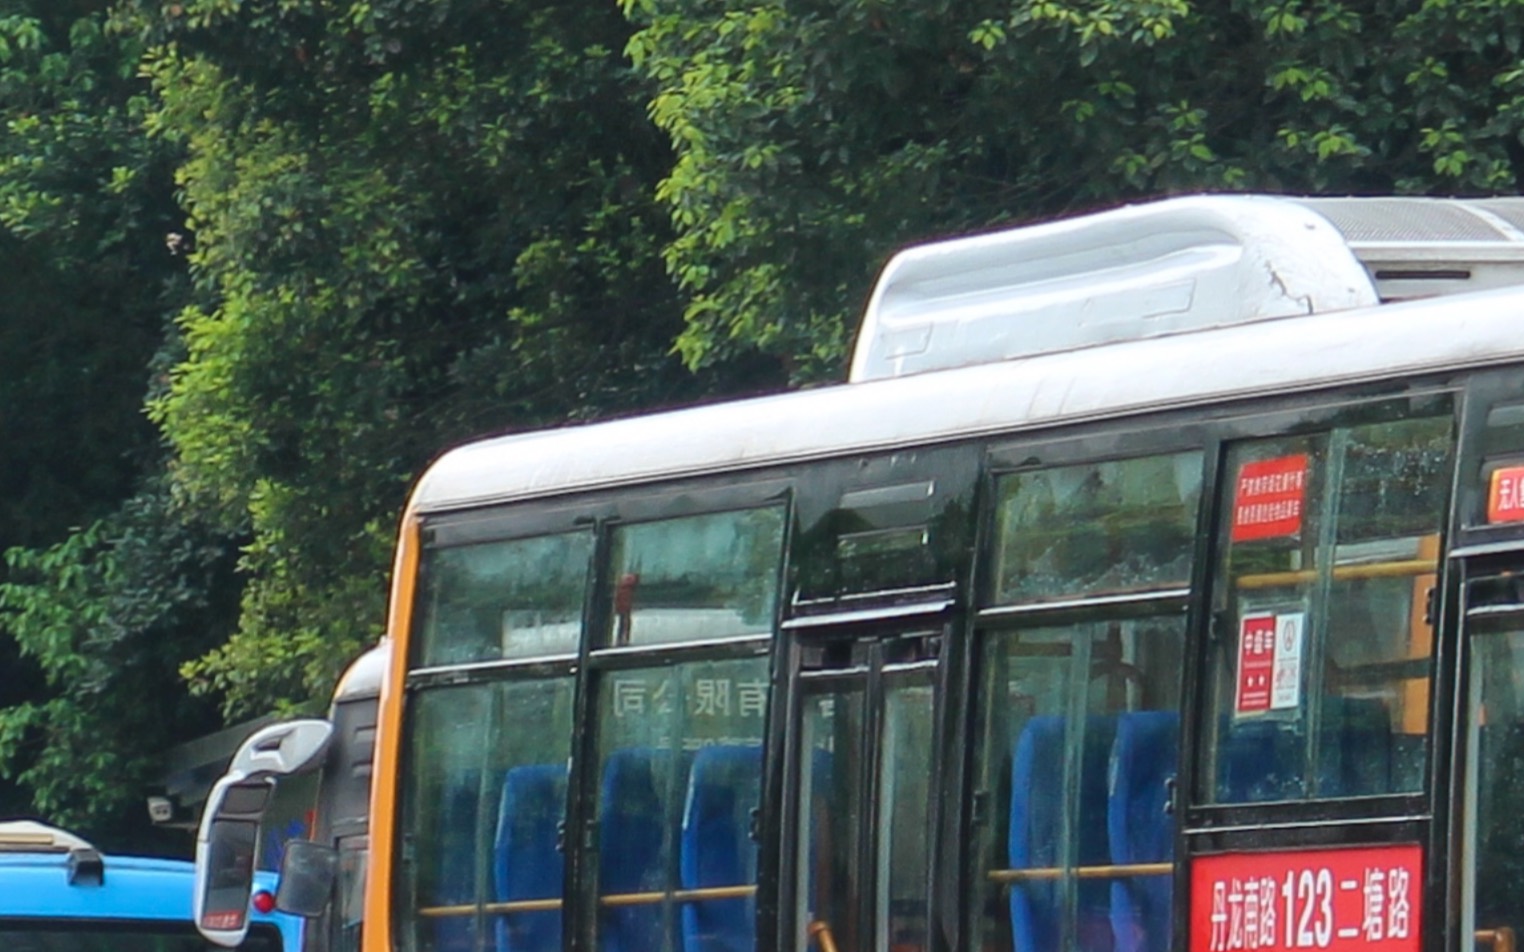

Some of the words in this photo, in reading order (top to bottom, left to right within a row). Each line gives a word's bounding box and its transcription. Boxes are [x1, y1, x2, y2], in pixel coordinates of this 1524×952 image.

[1210, 879, 1277, 952] 丹龙南路
[1282, 868, 1333, 949] 123
[1338, 867, 1410, 942] 二塘路
